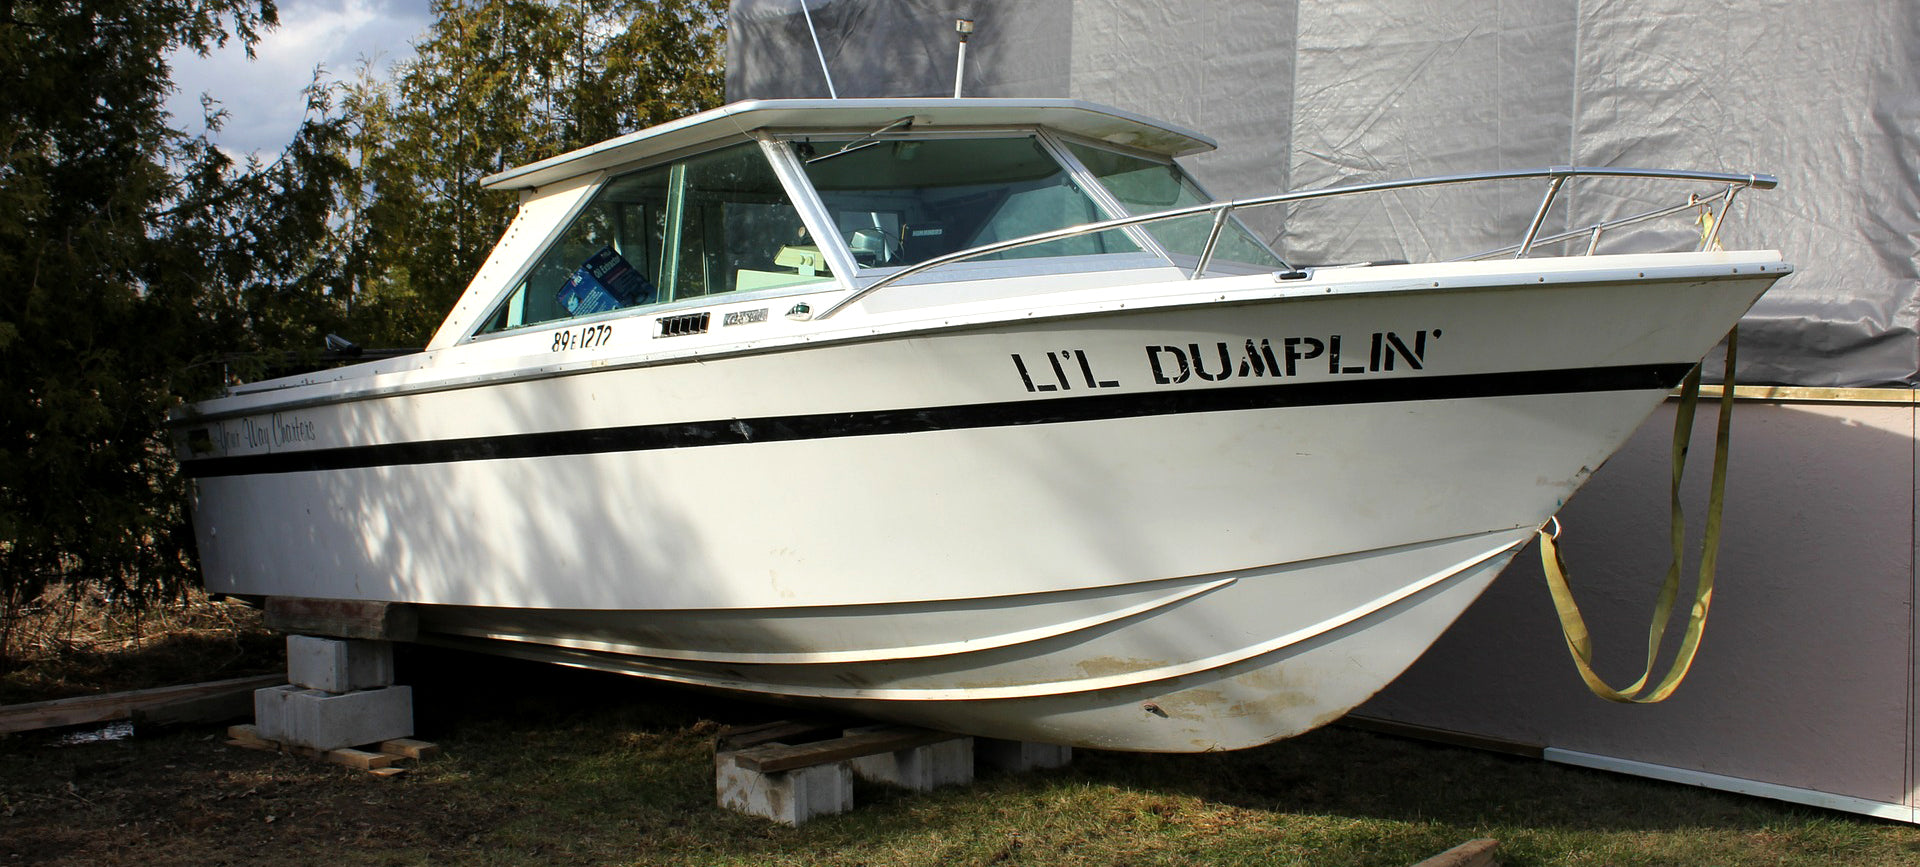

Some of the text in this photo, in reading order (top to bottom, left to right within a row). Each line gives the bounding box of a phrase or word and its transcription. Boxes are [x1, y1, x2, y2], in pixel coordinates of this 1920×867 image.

[1145, 328, 1443, 385] DUMPLIN'
[243, 417, 271, 453] Way
[272, 412, 316, 448] Charters
